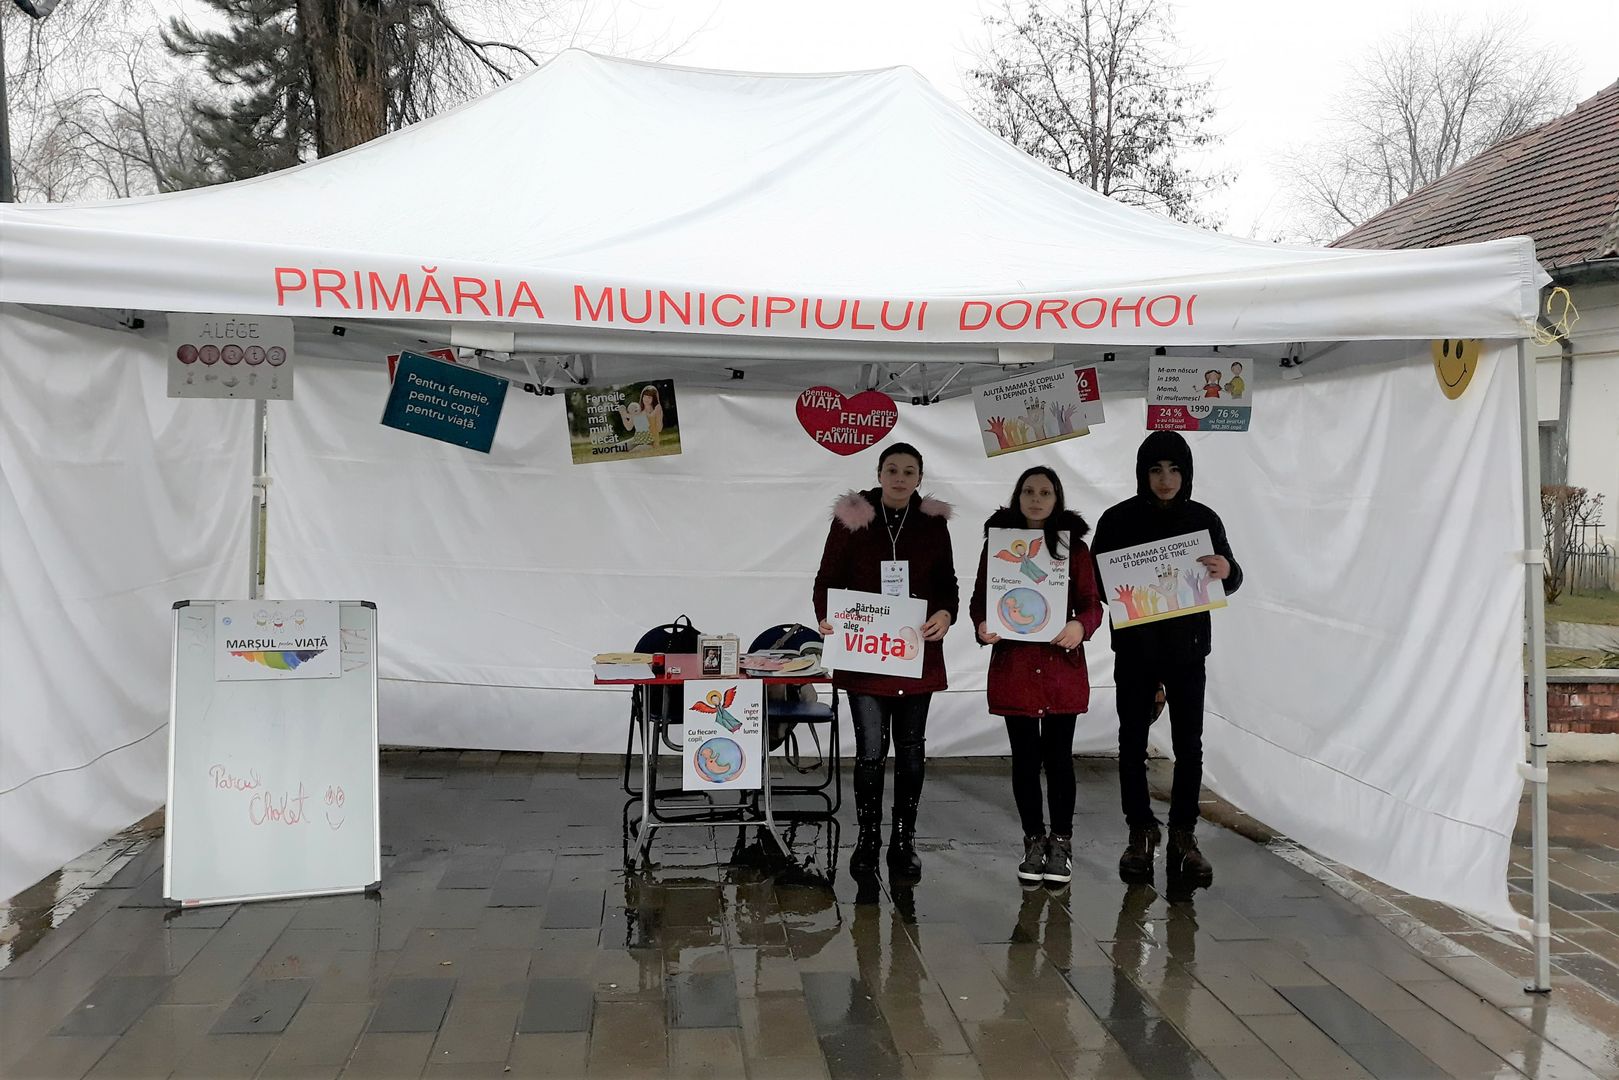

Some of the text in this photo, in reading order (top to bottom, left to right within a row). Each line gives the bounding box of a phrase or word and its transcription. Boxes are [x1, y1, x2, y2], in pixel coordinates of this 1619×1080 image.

[274, 265, 1198, 331] PRIMĂRIA MUNICIPIULUI DOROHOI
[199, 323, 260, 339] ALEGE
[407, 373, 490, 406] Pentru femeie,
[983, 386, 1003, 397] AJUTĂ
[1005, 382, 1028, 391] MAMA
[1036, 372, 1065, 385] COPILUL!
[1003, 388, 1027, 400] DEPIND
[1028, 386, 1037, 394] DE
[1039, 382, 1055, 391] TINE.
[408, 391, 481, 418] pentru copil,
[585, 392, 626, 404] Femeile
[801, 394, 842, 411] VIAȚĂ
[1160, 408, 1182, 417] 24 %
[1190, 405, 1210, 413] 1990
[1217, 409, 1240, 418] 76 %
[405, 404, 477, 430] pentru viață.
[588, 414, 608, 425] mai
[840, 412, 893, 428] FEMEIE
[589, 424, 614, 434] mult
[816, 431, 874, 445] FAMILIE
[592, 443, 628, 456] avortul
[1109, 552, 1132, 565] AJUTĂ
[1133, 547, 1159, 559] MAMA
[1168, 538, 1200, 552] COPILUL!
[1123, 560, 1130, 568] EI
[1131, 555, 1158, 567] DEPIND
[1159, 553, 1169, 561] DE
[843, 621, 859, 632] aleg
[226, 638, 276, 650] MARȘUL
[295, 636, 328, 650] VIAȚĂ
[845, 627, 906, 661] viața
